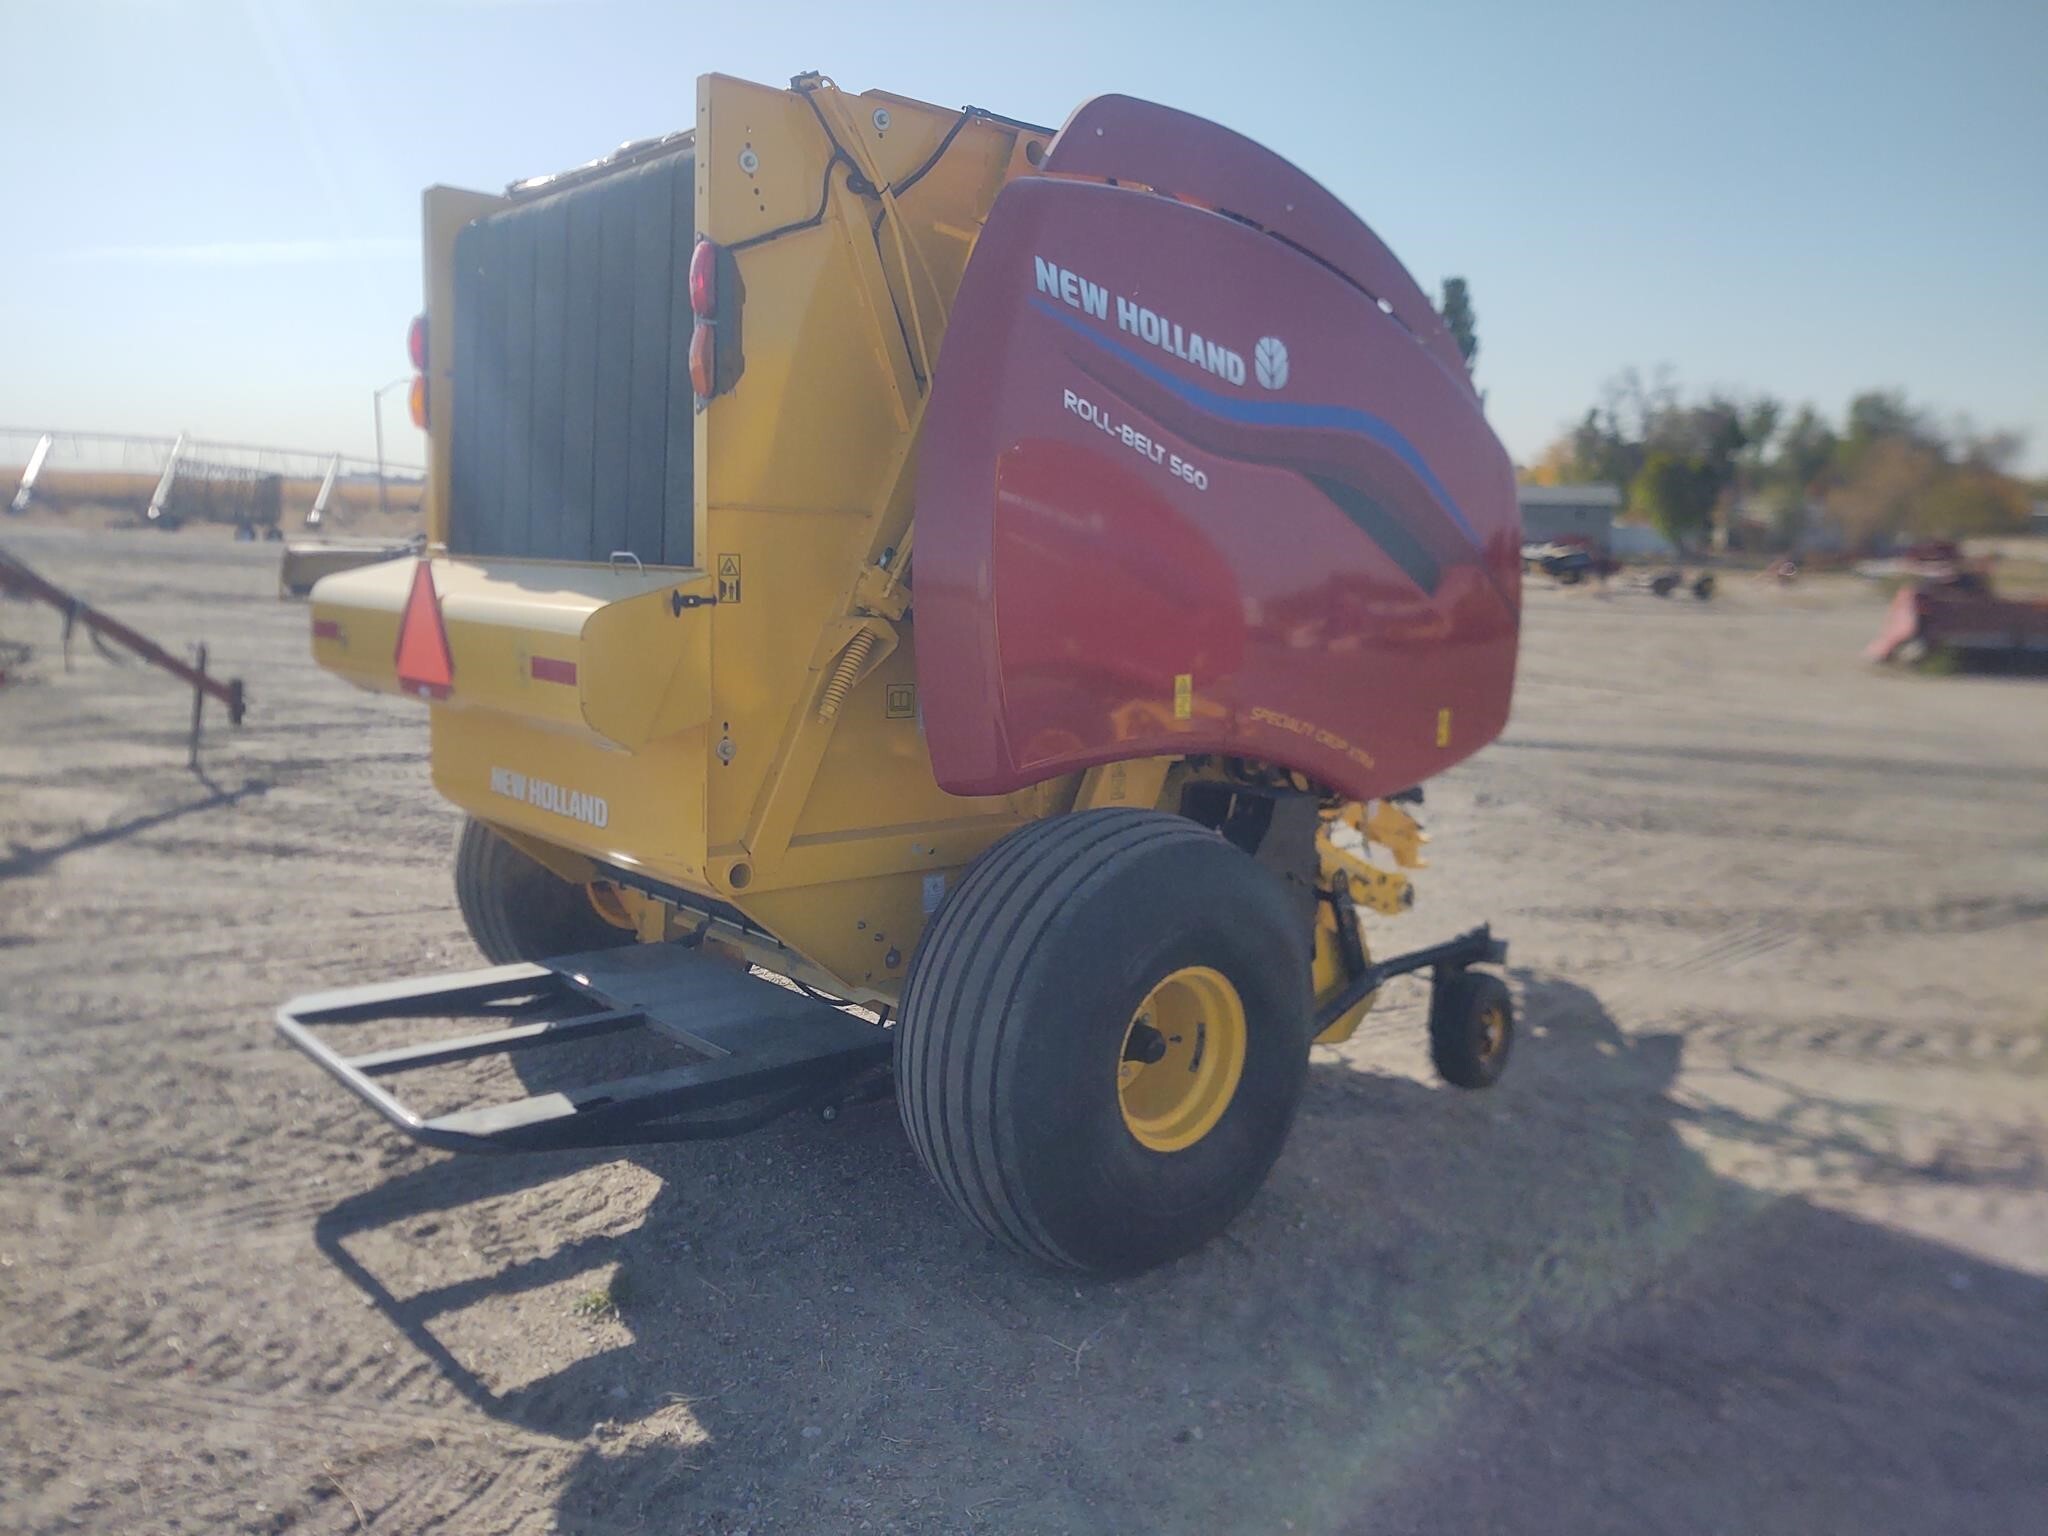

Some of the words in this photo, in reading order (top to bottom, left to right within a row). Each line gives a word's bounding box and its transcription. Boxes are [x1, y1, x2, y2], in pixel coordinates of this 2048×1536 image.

[1034, 255, 1109, 321] NEW
[1117, 296, 1246, 386] HOLLAND
[1063, 388, 1166, 465] ROLL-BELT
[1169, 454, 1208, 491] 560
[491, 767, 527, 801] NEW
[528, 777, 609, 829] HOLLAND
